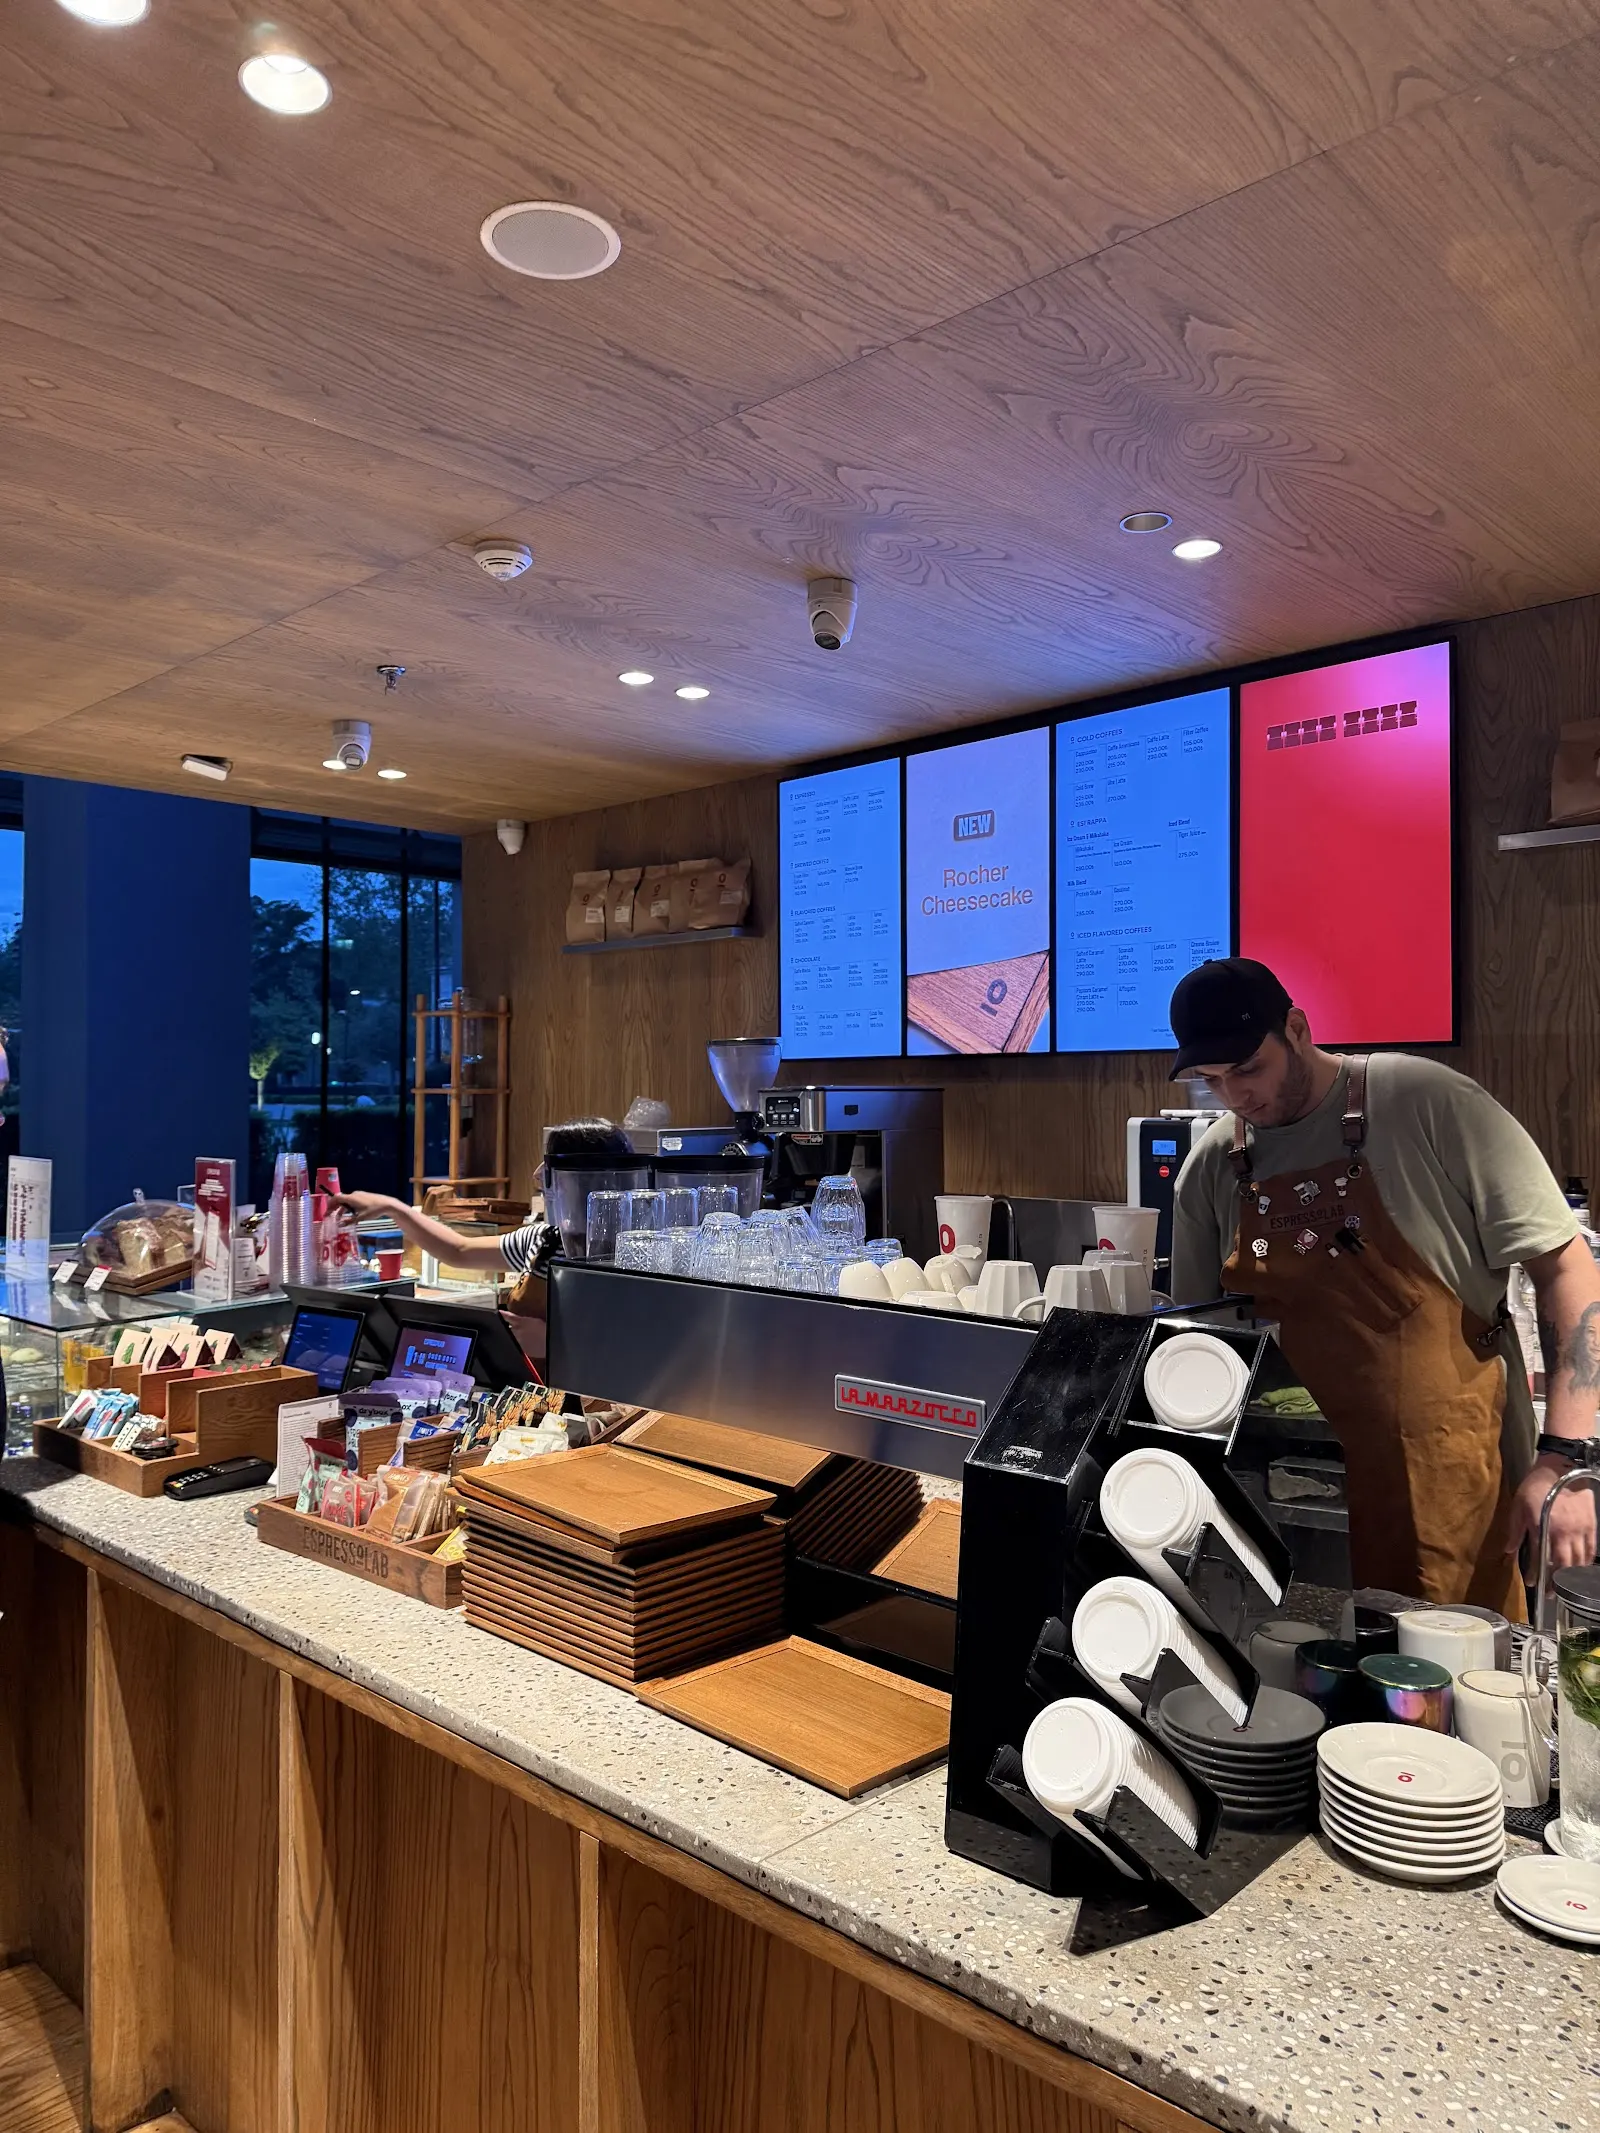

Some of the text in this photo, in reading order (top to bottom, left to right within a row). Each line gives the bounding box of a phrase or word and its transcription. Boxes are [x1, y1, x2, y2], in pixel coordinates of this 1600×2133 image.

[1077, 733, 1094, 743] COLD
[958, 813, 992, 837] NEW
[943, 864, 1009, 889] Rocher
[922, 886, 1033, 916] Cheesecake
[1092, 928, 1123, 938] FLAVORED
[1124, 926, 1152, 935] COFFEES
